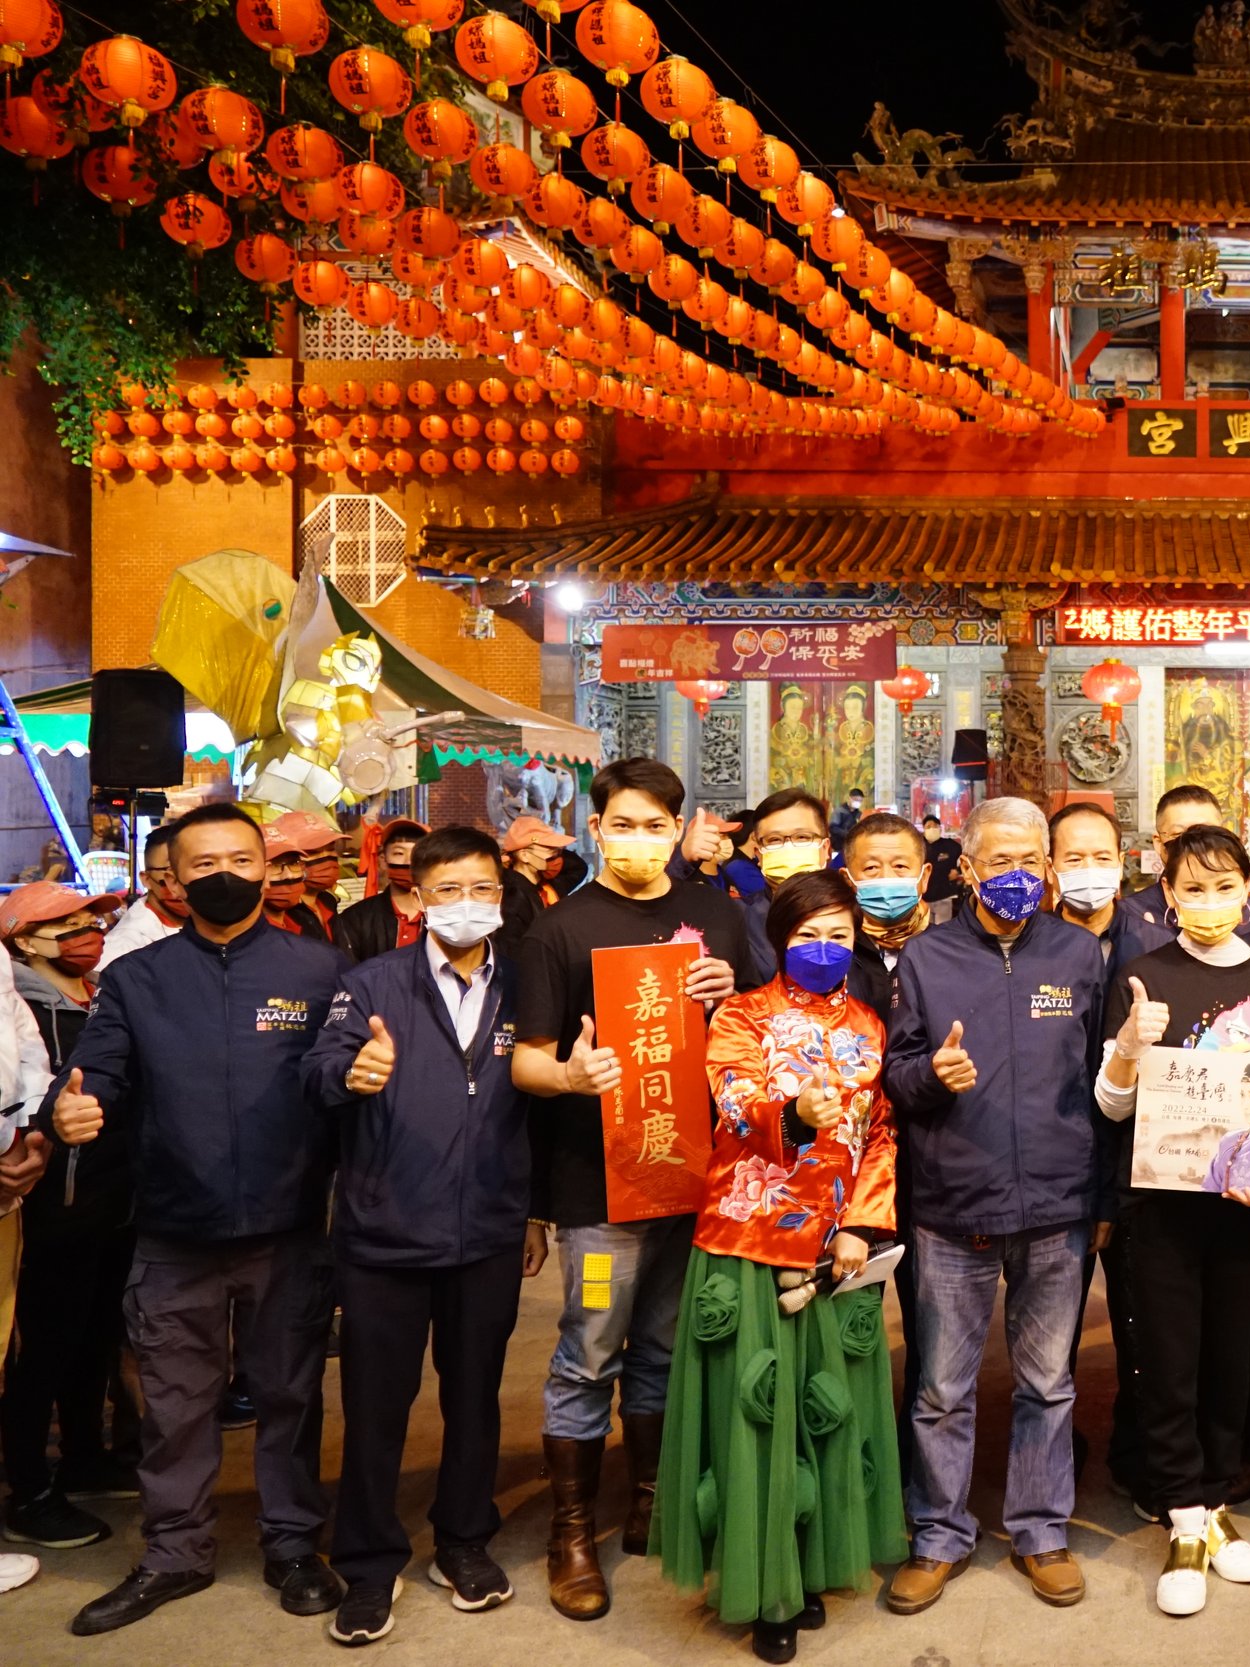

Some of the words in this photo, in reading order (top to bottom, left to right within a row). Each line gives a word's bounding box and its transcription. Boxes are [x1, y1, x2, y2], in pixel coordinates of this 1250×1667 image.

[789, 627, 839, 643] 祈福
[789, 645, 866, 671] 保平安
[1031, 998, 1072, 1008] MATZU
[256, 1012, 308, 1022] MATZU
[624, 967, 687, 1167] 嘉福同慶
[1162, 1104, 1207, 1114] 2022.2.24
